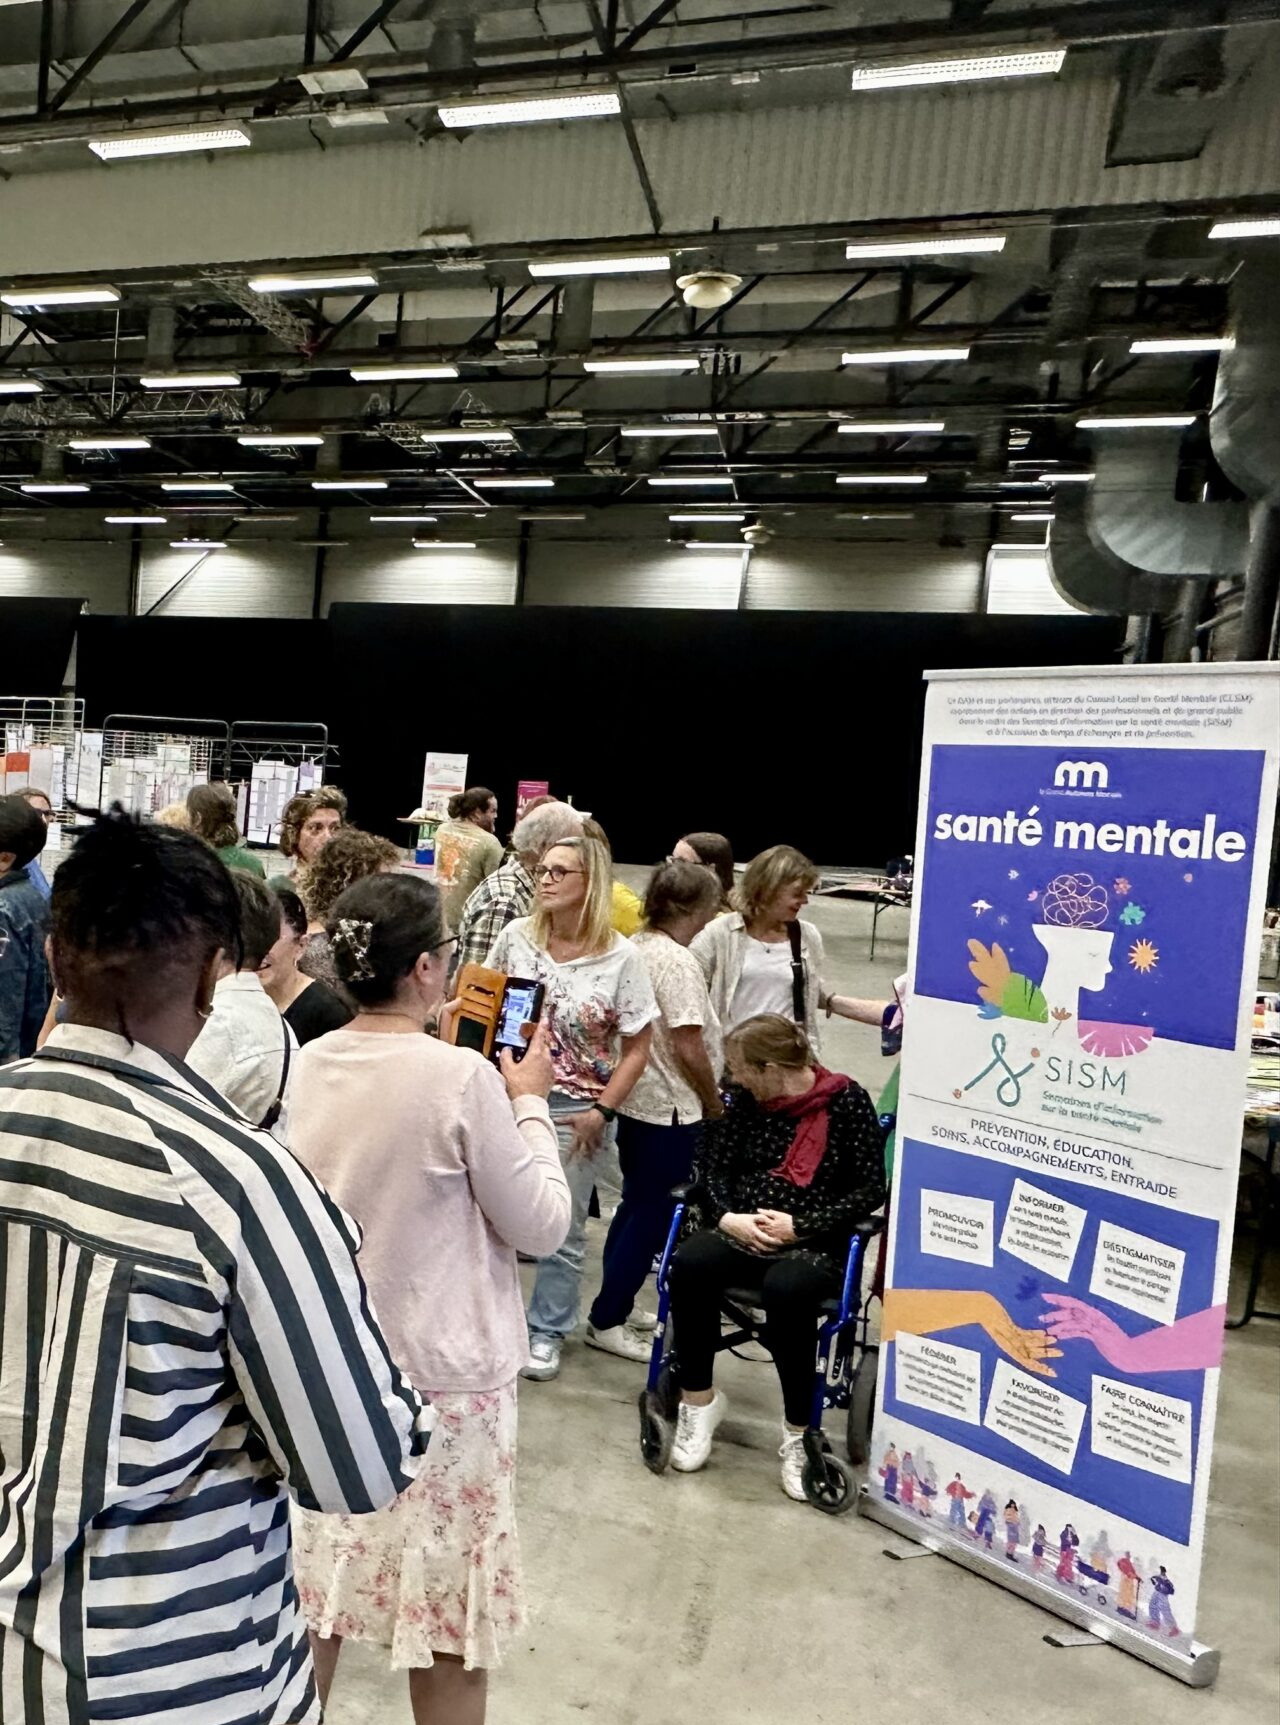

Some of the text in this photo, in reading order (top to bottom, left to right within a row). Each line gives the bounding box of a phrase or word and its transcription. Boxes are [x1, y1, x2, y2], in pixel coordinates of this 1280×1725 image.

[933, 805, 1246, 862] santé mentale
[1045, 1056, 1126, 1096] SISM
[1111, 1170, 1178, 1199] ENTRAIDE
